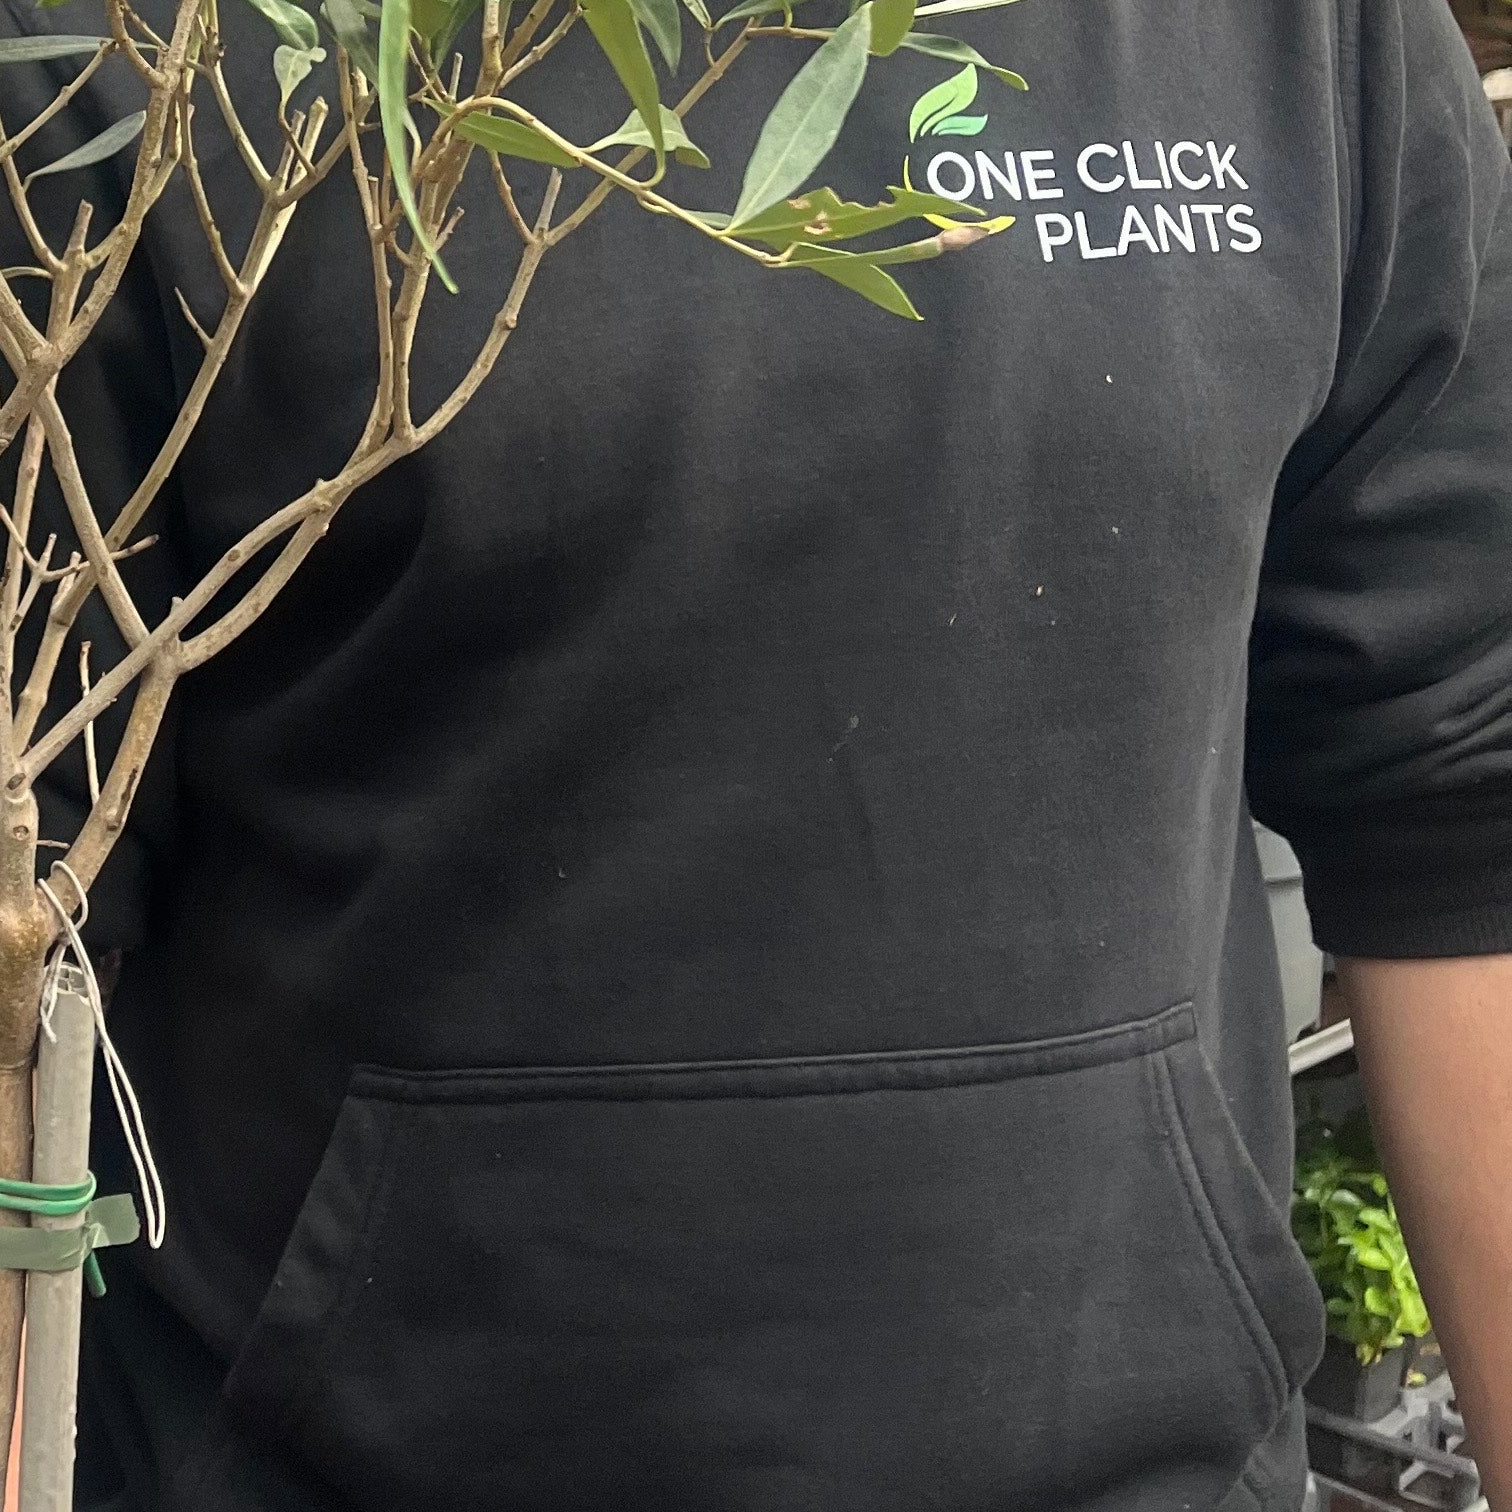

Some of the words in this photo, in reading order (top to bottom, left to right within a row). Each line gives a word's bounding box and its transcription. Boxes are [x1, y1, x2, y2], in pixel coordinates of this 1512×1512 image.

[926, 150, 1065, 202] ONE
[1076, 140, 1250, 194] CLICK
[1034, 203, 1263, 264] PLANTS
